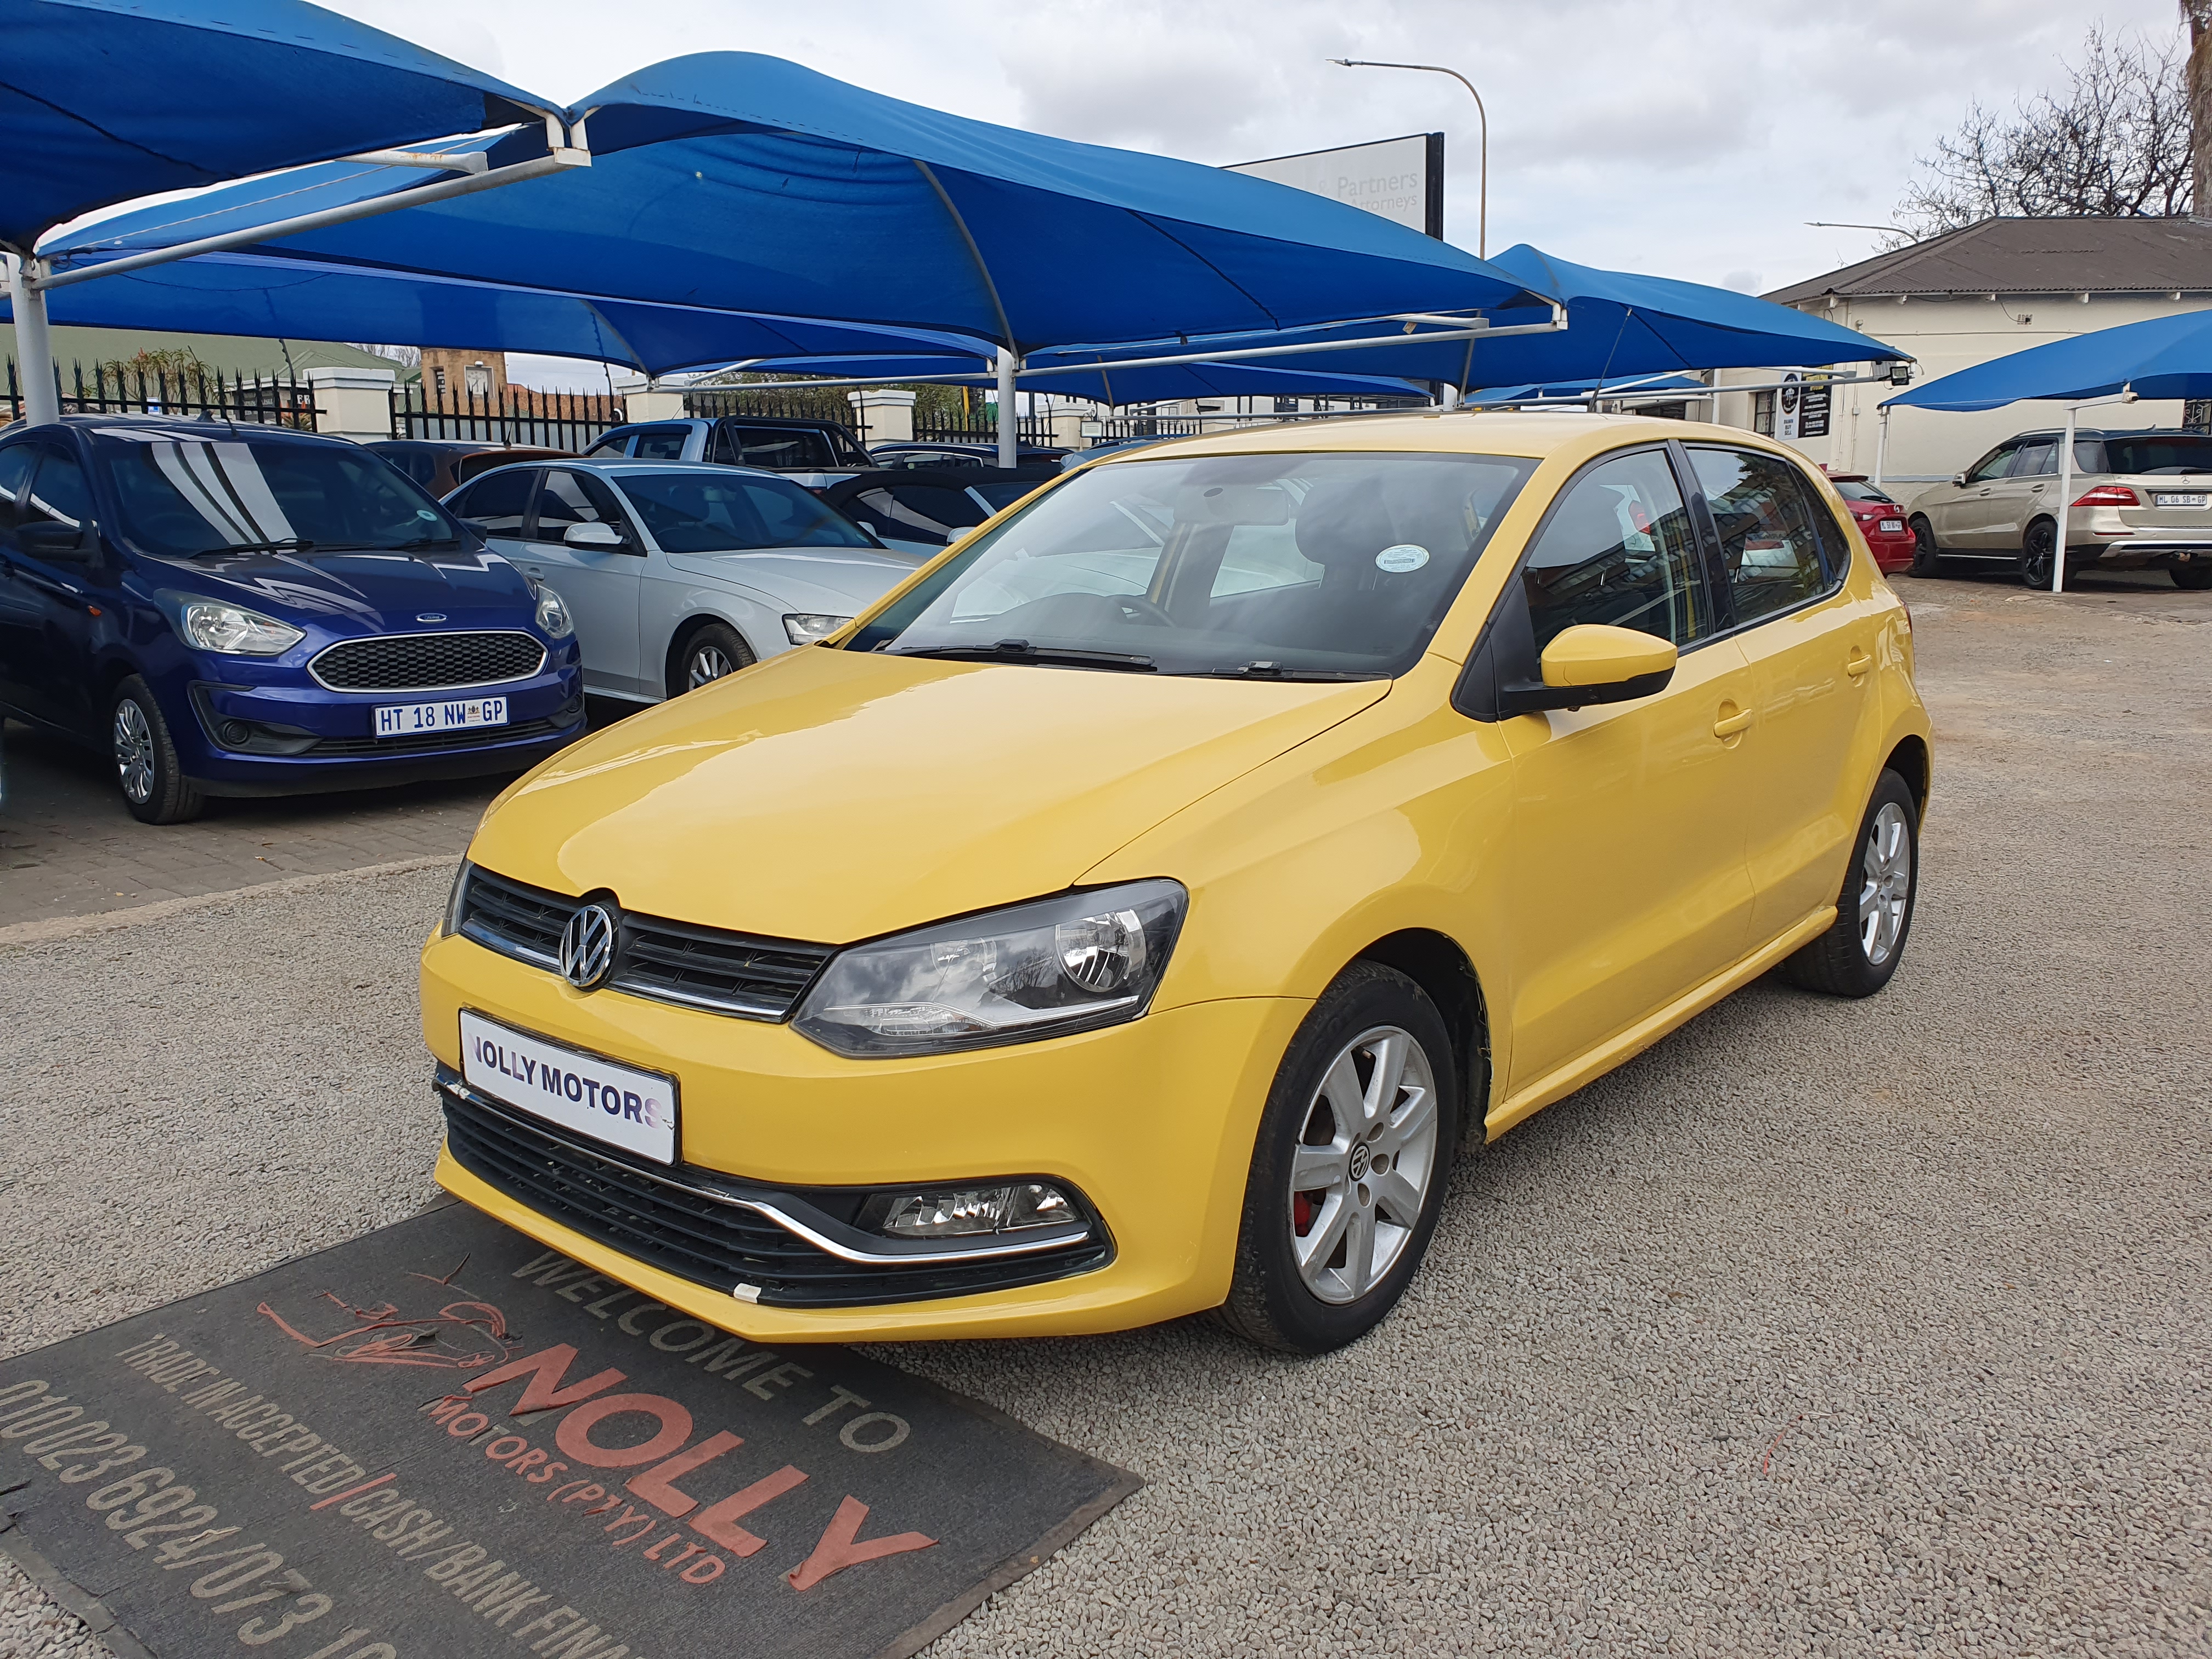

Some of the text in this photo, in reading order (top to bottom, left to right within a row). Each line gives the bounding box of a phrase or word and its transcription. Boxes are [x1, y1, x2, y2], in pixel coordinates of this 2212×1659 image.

[1338, 172, 1418, 199] Partners
[1351, 195, 1418, 212] Attorneys
[381, 700, 503, 731] HT 18 NW GP
[468, 1031, 662, 1129] NOLLY MOTORS
[115, 1333, 221, 1393] TRADE
[180, 1377, 247, 1409] IN
[511, 1251, 911, 1453] WELCOME TO
[418, 1394, 726, 1584] MOTORS (PTY) LTD
[461, 1342, 939, 1592] NOLLY
